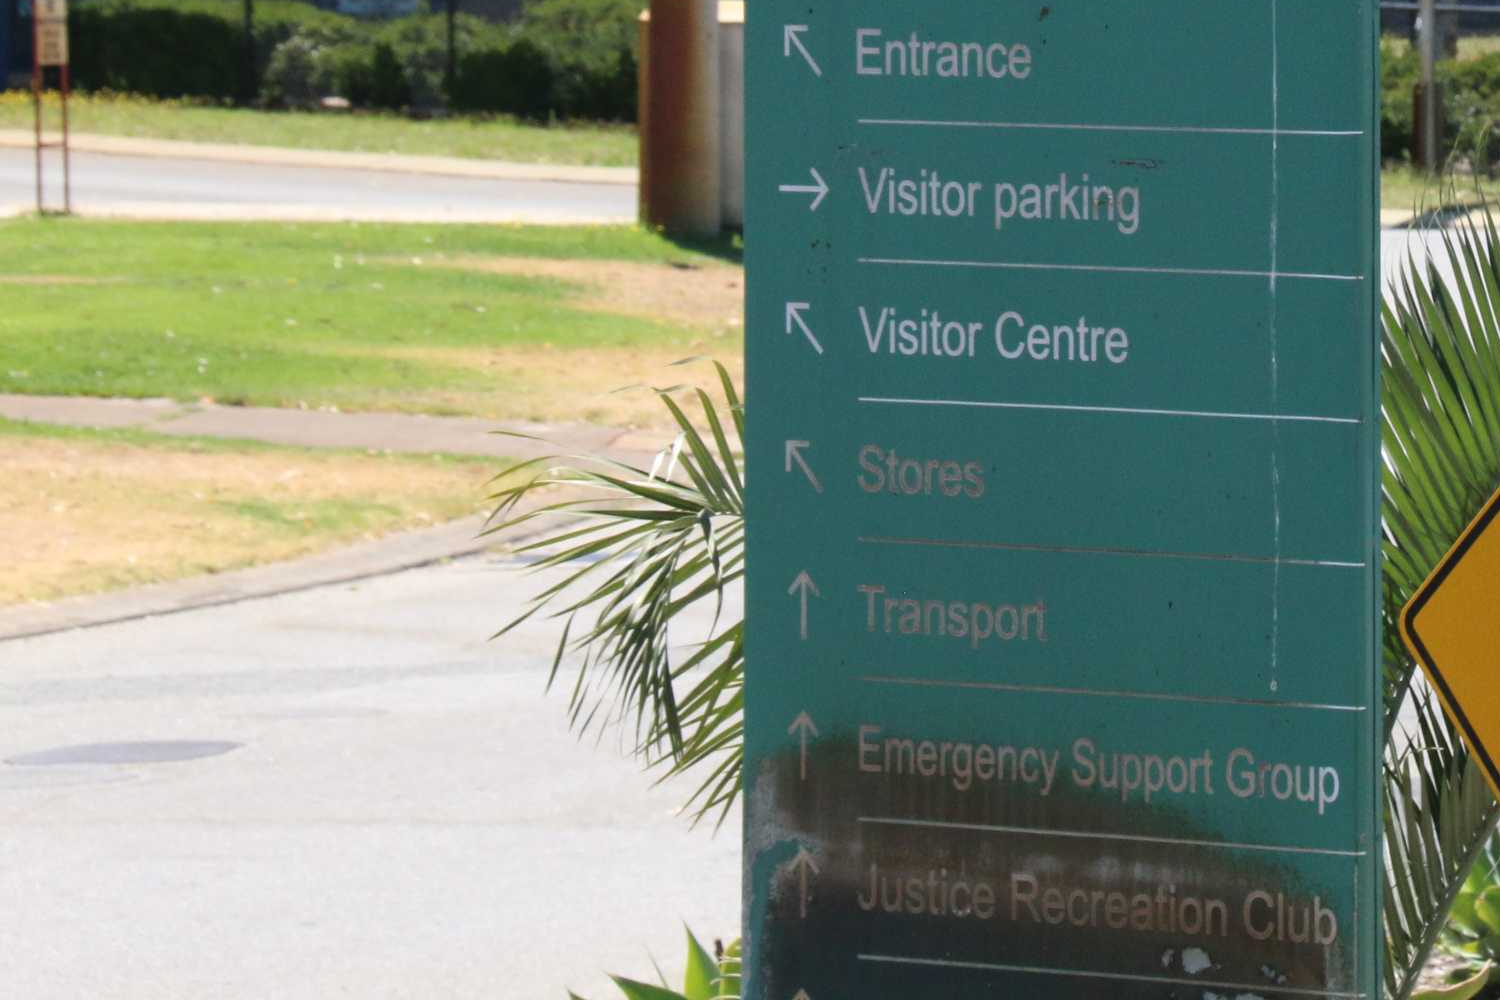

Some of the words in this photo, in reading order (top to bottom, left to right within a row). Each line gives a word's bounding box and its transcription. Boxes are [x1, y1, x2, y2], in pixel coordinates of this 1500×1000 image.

[856, 28, 1032, 79] Entrance
[857, 167, 983, 218] Visitor
[994, 173, 1140, 236] parking
[858, 306, 983, 358] Visitor
[995, 311, 1130, 365] Centre
[857, 444, 986, 499] Stores
[857, 582, 1048, 650] Transport
[857, 724, 1060, 792] Emergency
[1071, 737, 1214, 802] Support
[1225, 748, 1341, 815] Group
[857, 863, 997, 920] Justice
[1010, 873, 1229, 938] Recreation
[1242, 889, 1339, 946] Club
